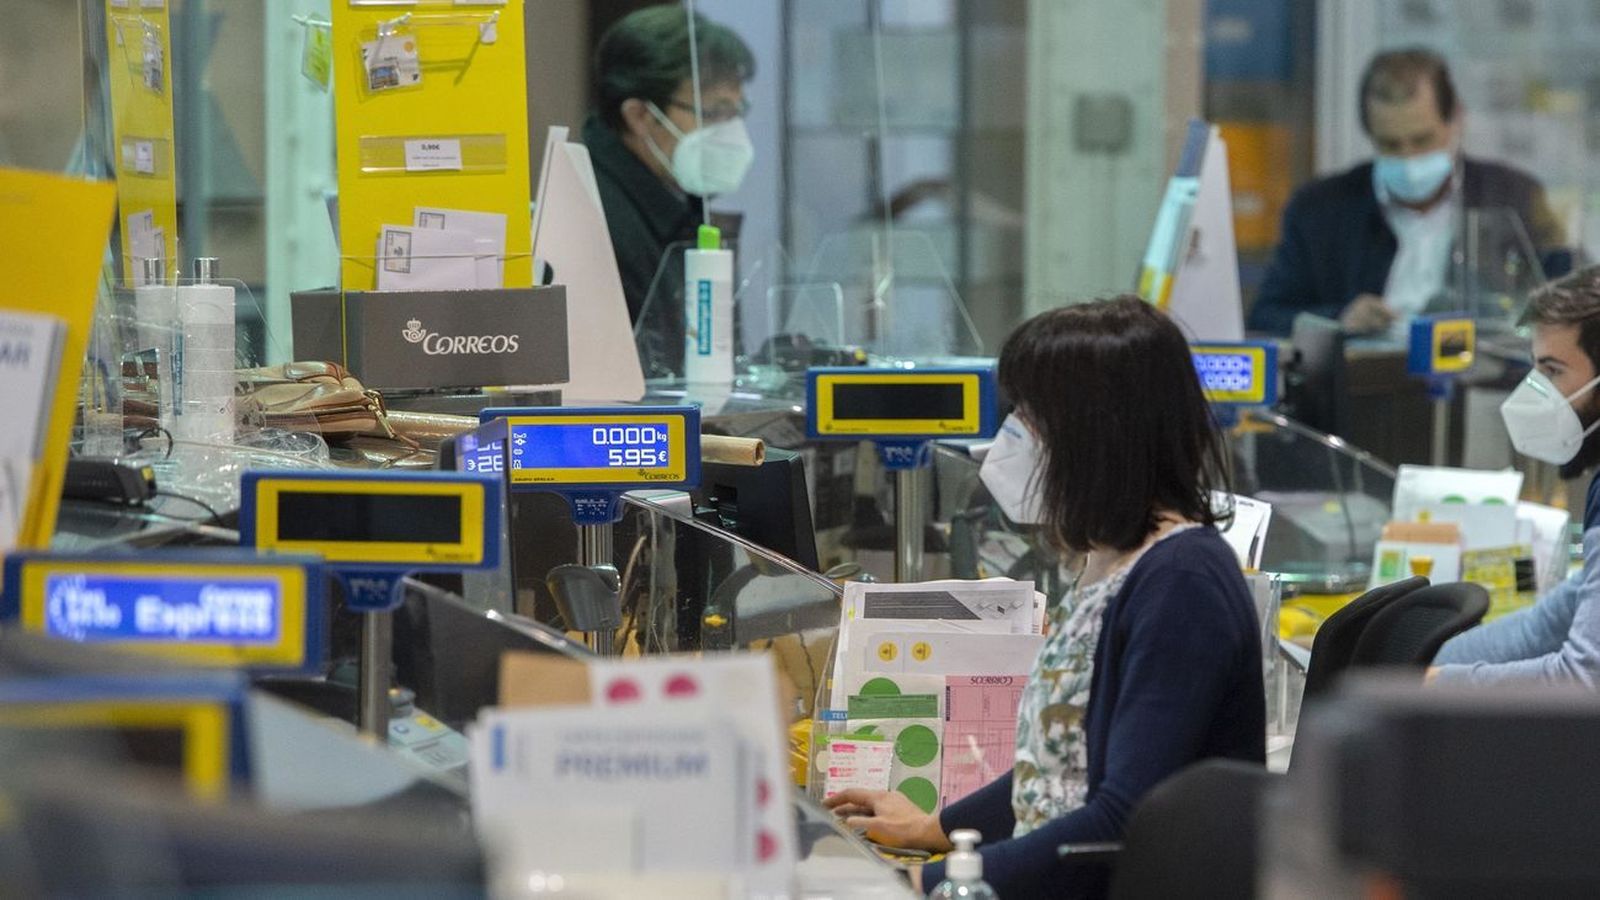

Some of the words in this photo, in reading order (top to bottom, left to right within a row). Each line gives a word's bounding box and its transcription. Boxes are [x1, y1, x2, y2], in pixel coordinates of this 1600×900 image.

[423, 332, 519, 356] CORREOS
[644, 471, 680, 481] CORREOS
[135, 594, 274, 638] Express
[970, 676, 1013, 685] CORREOS
